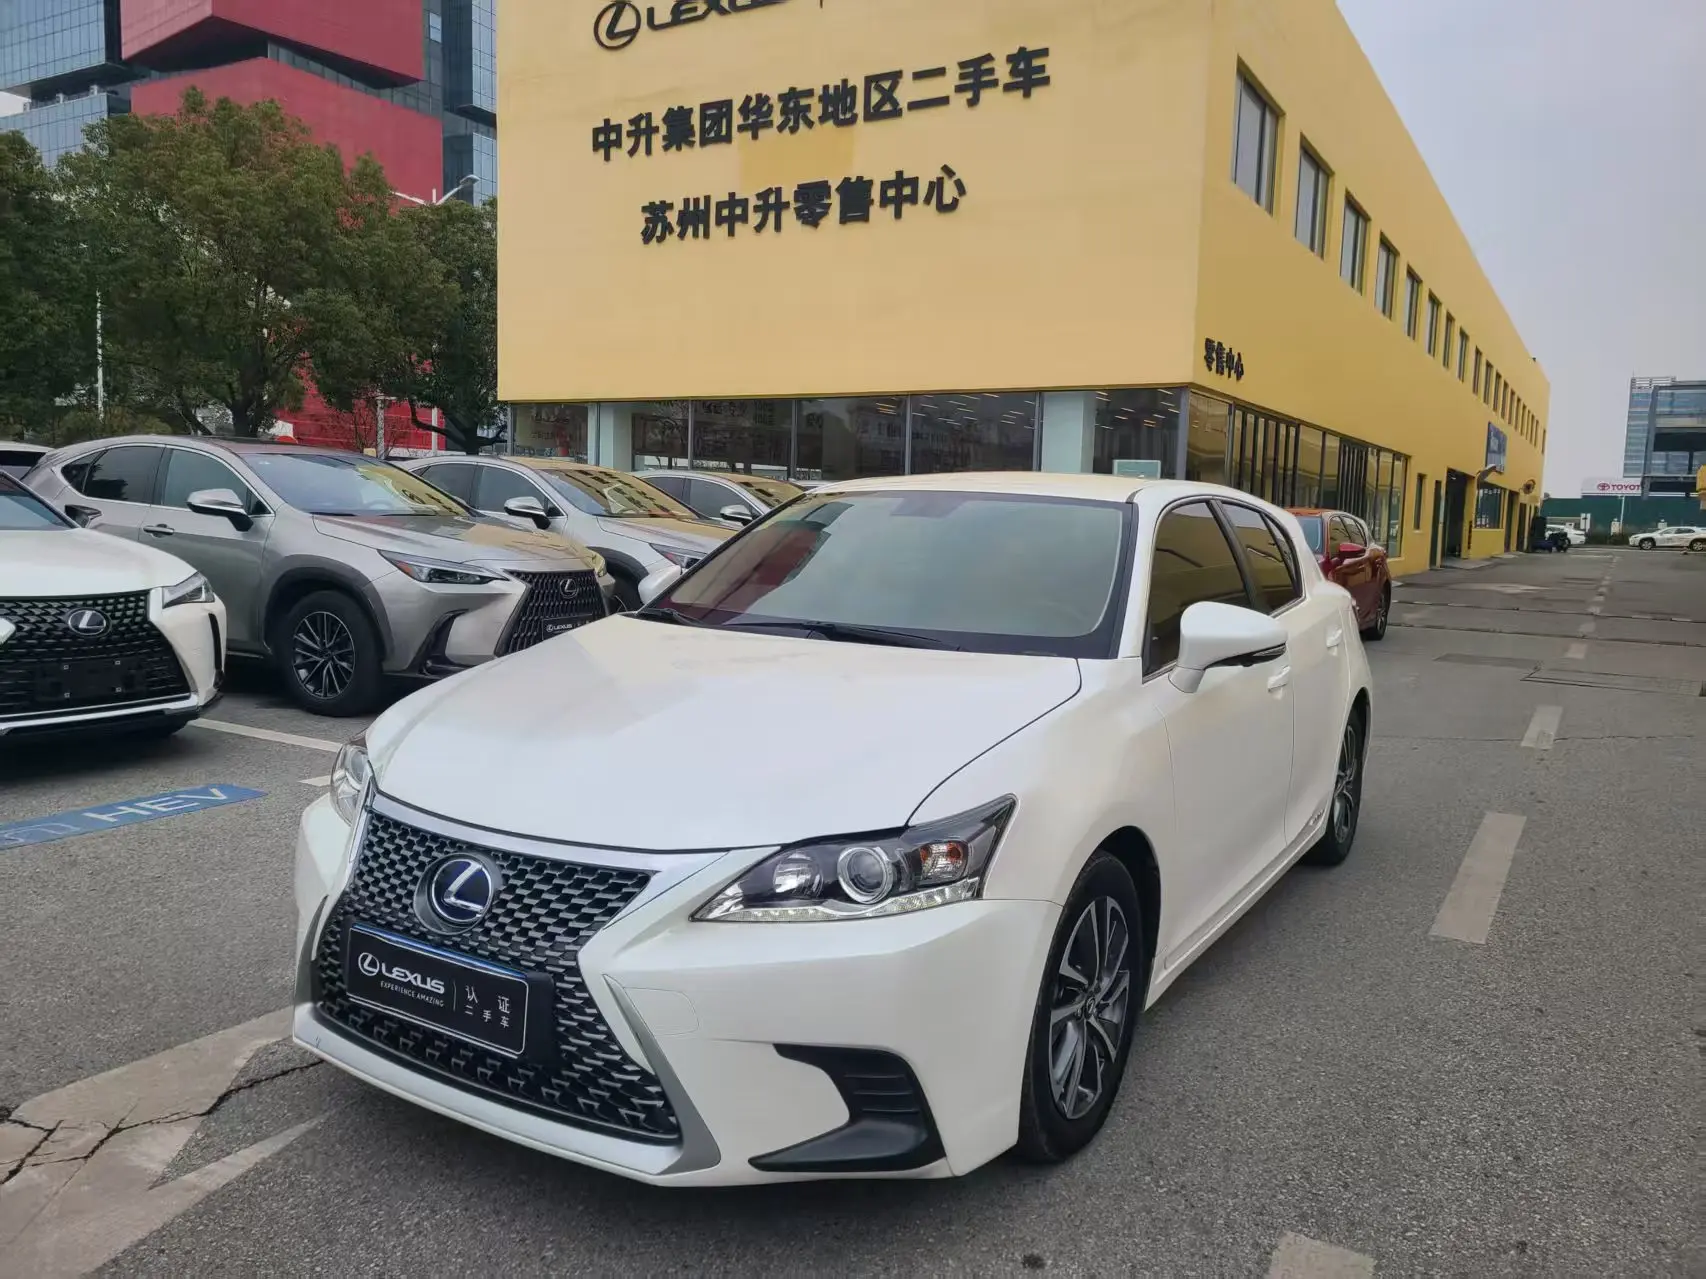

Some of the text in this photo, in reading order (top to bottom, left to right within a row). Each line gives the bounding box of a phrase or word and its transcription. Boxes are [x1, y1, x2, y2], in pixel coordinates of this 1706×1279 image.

[592, 46, 1051, 162] 中升集团华东地区二手车
[640, 164, 967, 245] 苏州中升零售中心
[1204, 337, 1244, 381] 零售中心
[82, 787, 228, 823] HEV
[380, 980, 444, 1008] EXPERIENCE AMAZING
[381, 962, 445, 994] LEXUS
[465, 984, 511, 1014] 认证
[464, 1004, 510, 1029] 二手车
